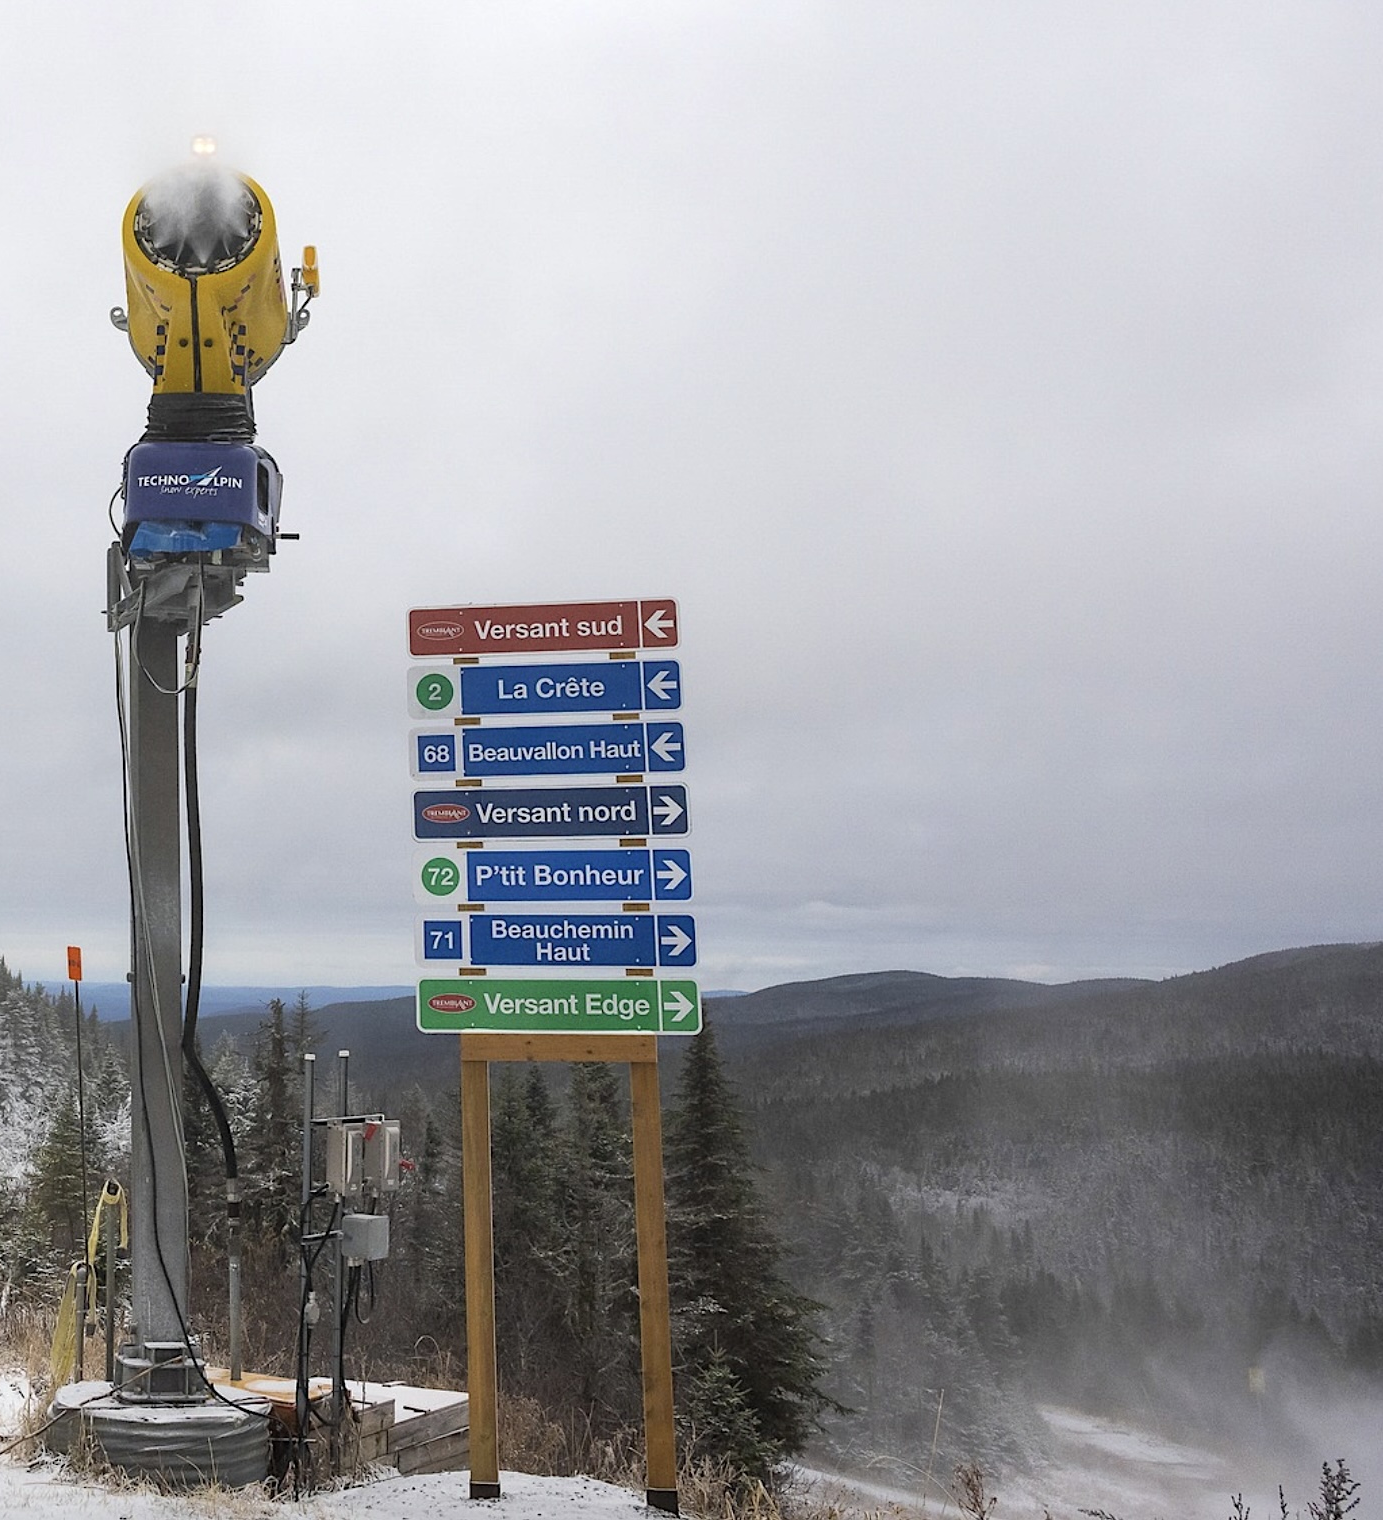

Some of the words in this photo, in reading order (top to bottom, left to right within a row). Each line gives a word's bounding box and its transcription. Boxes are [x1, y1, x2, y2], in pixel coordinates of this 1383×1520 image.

[474, 618, 570, 640] Versant
[577, 615, 623, 637] sud
[428, 683, 442, 701] 2
[498, 679, 528, 700] La
[535, 677, 605, 699] Crête
[423, 745, 450, 764] 68
[468, 741, 585, 763] Beauvallon
[589, 739, 642, 759] Haut
[475, 803, 572, 824] Versant
[578, 800, 637, 823] nord
[427, 868, 454, 886] 72
[475, 864, 527, 886] P'tit
[534, 864, 644, 886] Bonheur
[429, 931, 454, 949] 71
[491, 919, 634, 940] Beauchemin
[536, 942, 591, 962] Haut
[483, 992, 578, 1016] Versant
[585, 993, 651, 1020] Edge
